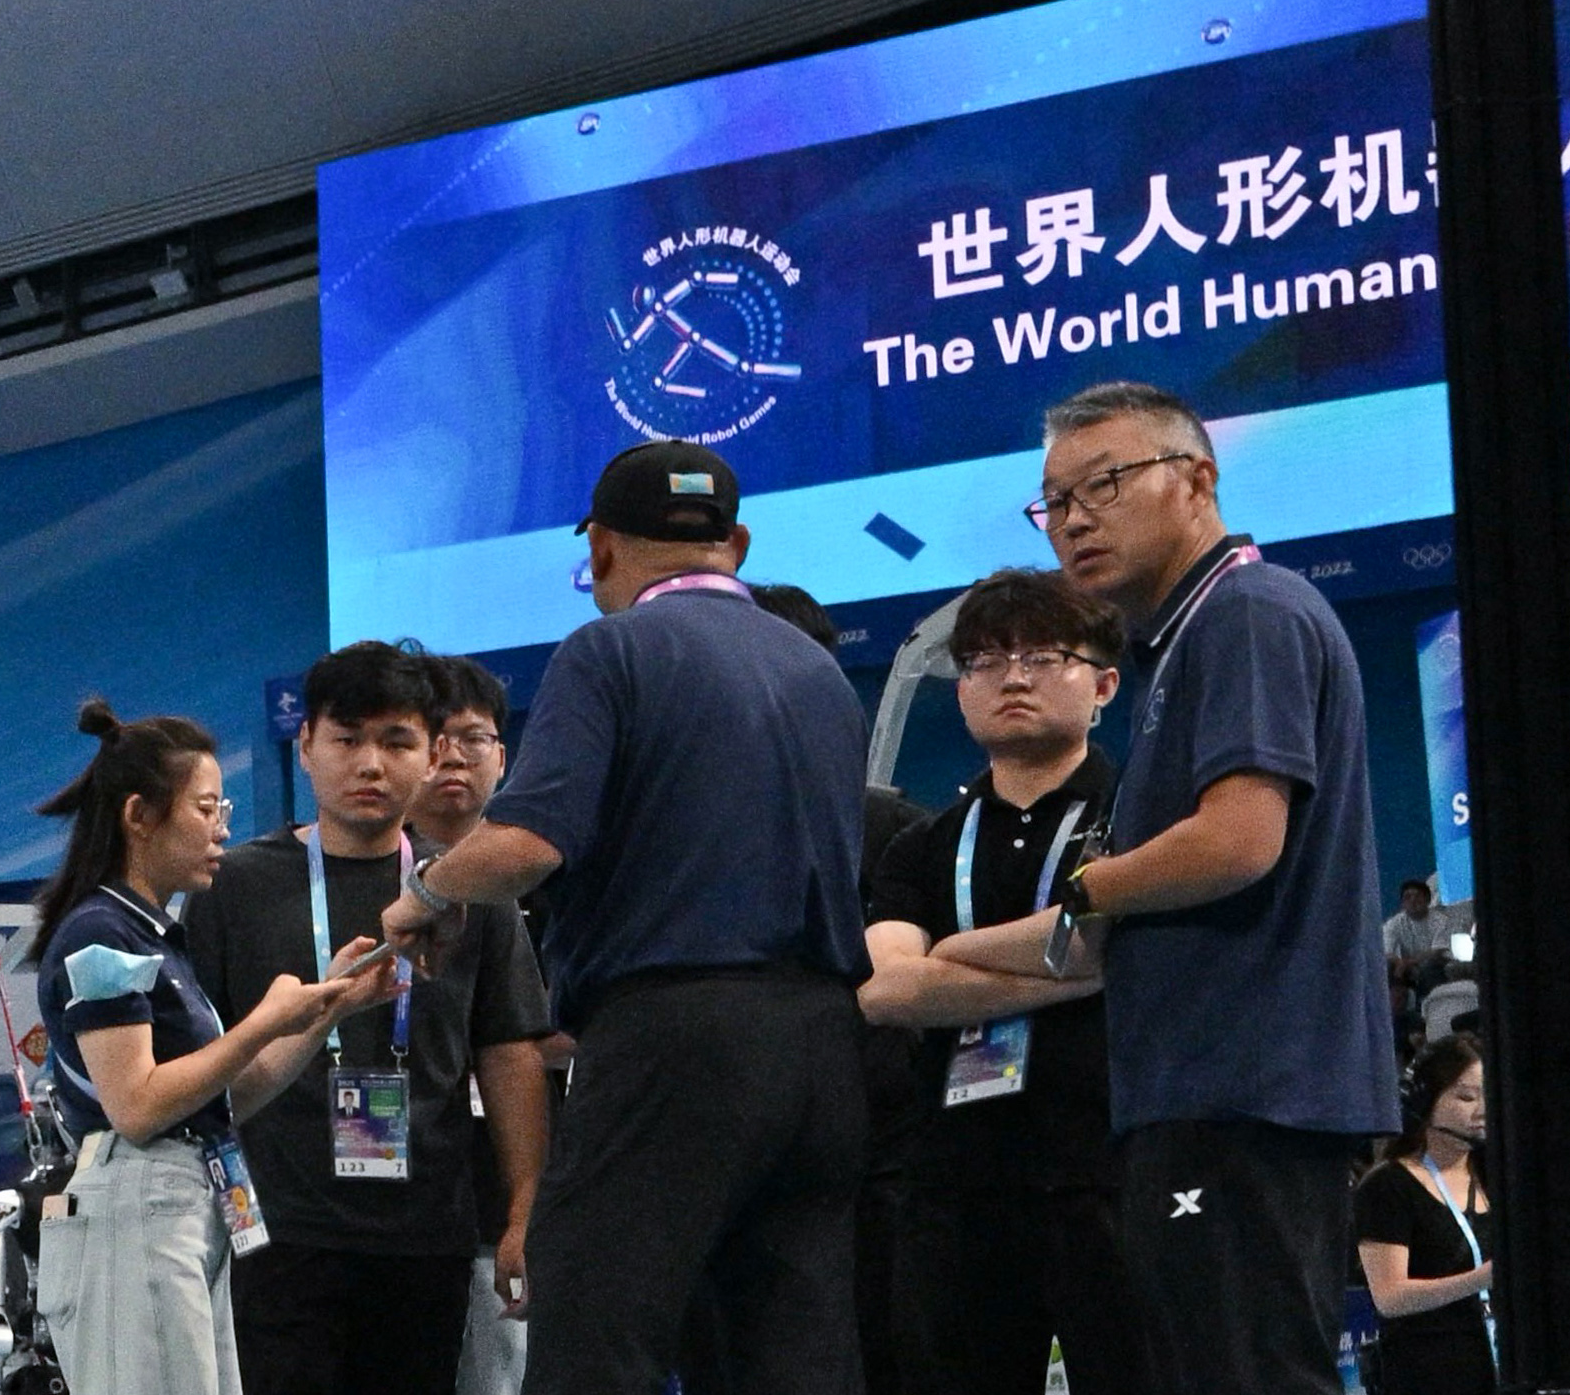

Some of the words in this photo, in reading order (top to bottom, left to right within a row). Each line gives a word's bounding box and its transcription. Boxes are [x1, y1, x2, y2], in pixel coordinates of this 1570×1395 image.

[642, 226, 801, 287] 世界人形机器人运动会
[918, 128, 1438, 298] 世界人形机
[863, 333, 975, 387] The
[992, 285, 1182, 365] World
